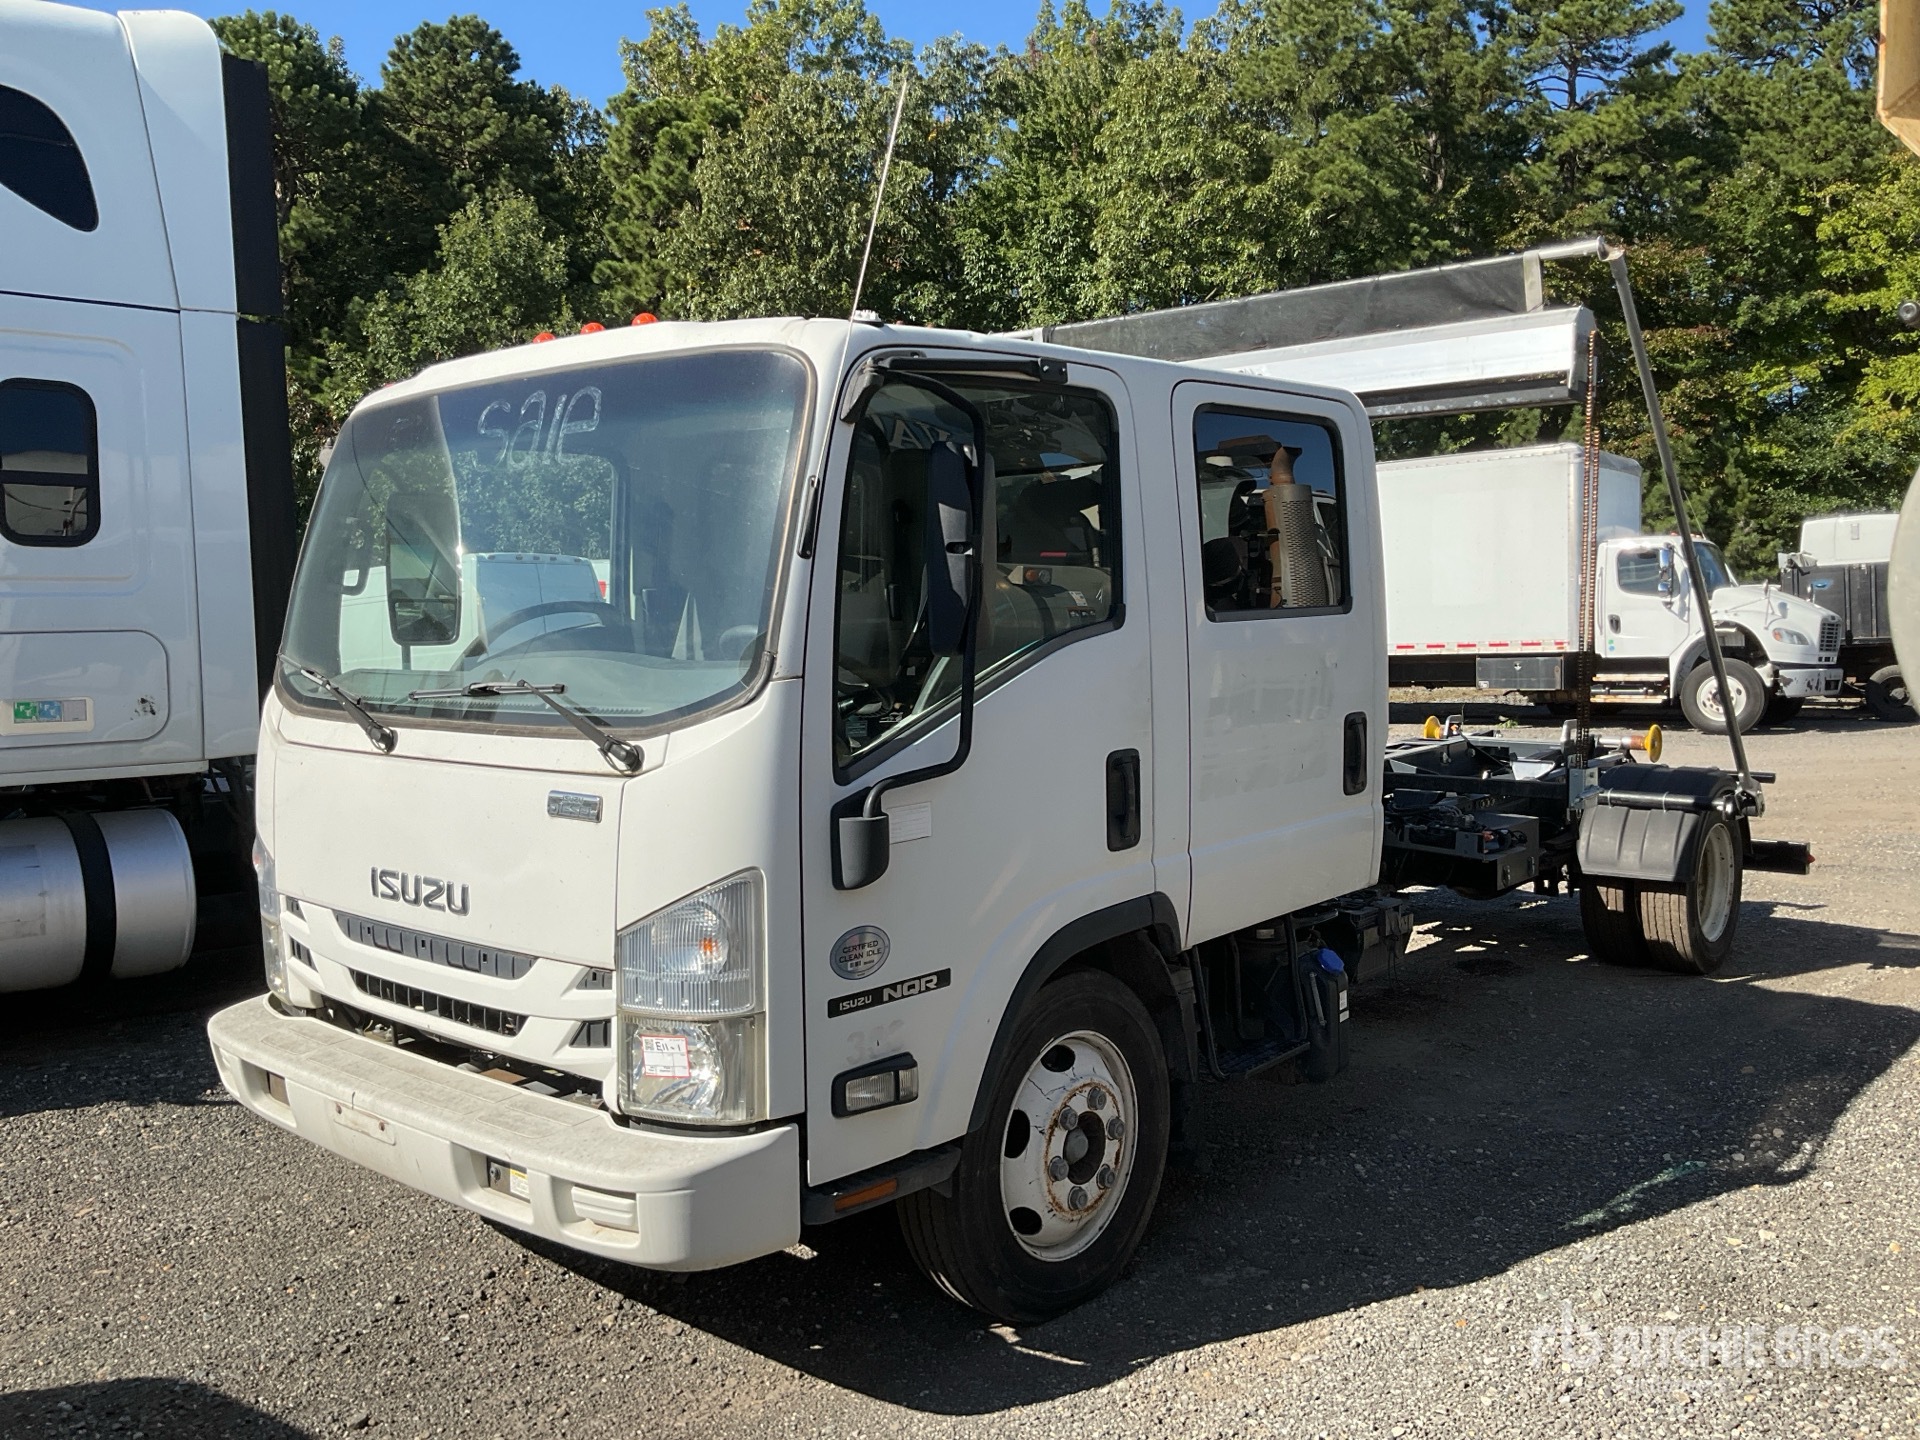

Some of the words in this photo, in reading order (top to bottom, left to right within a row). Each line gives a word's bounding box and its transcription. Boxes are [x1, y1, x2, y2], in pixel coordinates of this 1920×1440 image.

[371, 866, 470, 916] ISUZU
[839, 952, 863, 963] CLEAN
[867, 948, 881, 956] IDLE
[843, 941, 878, 953] CERTIFIED
[840, 995, 872, 1010] ISUZU
[883, 975, 937, 1001] NQR
